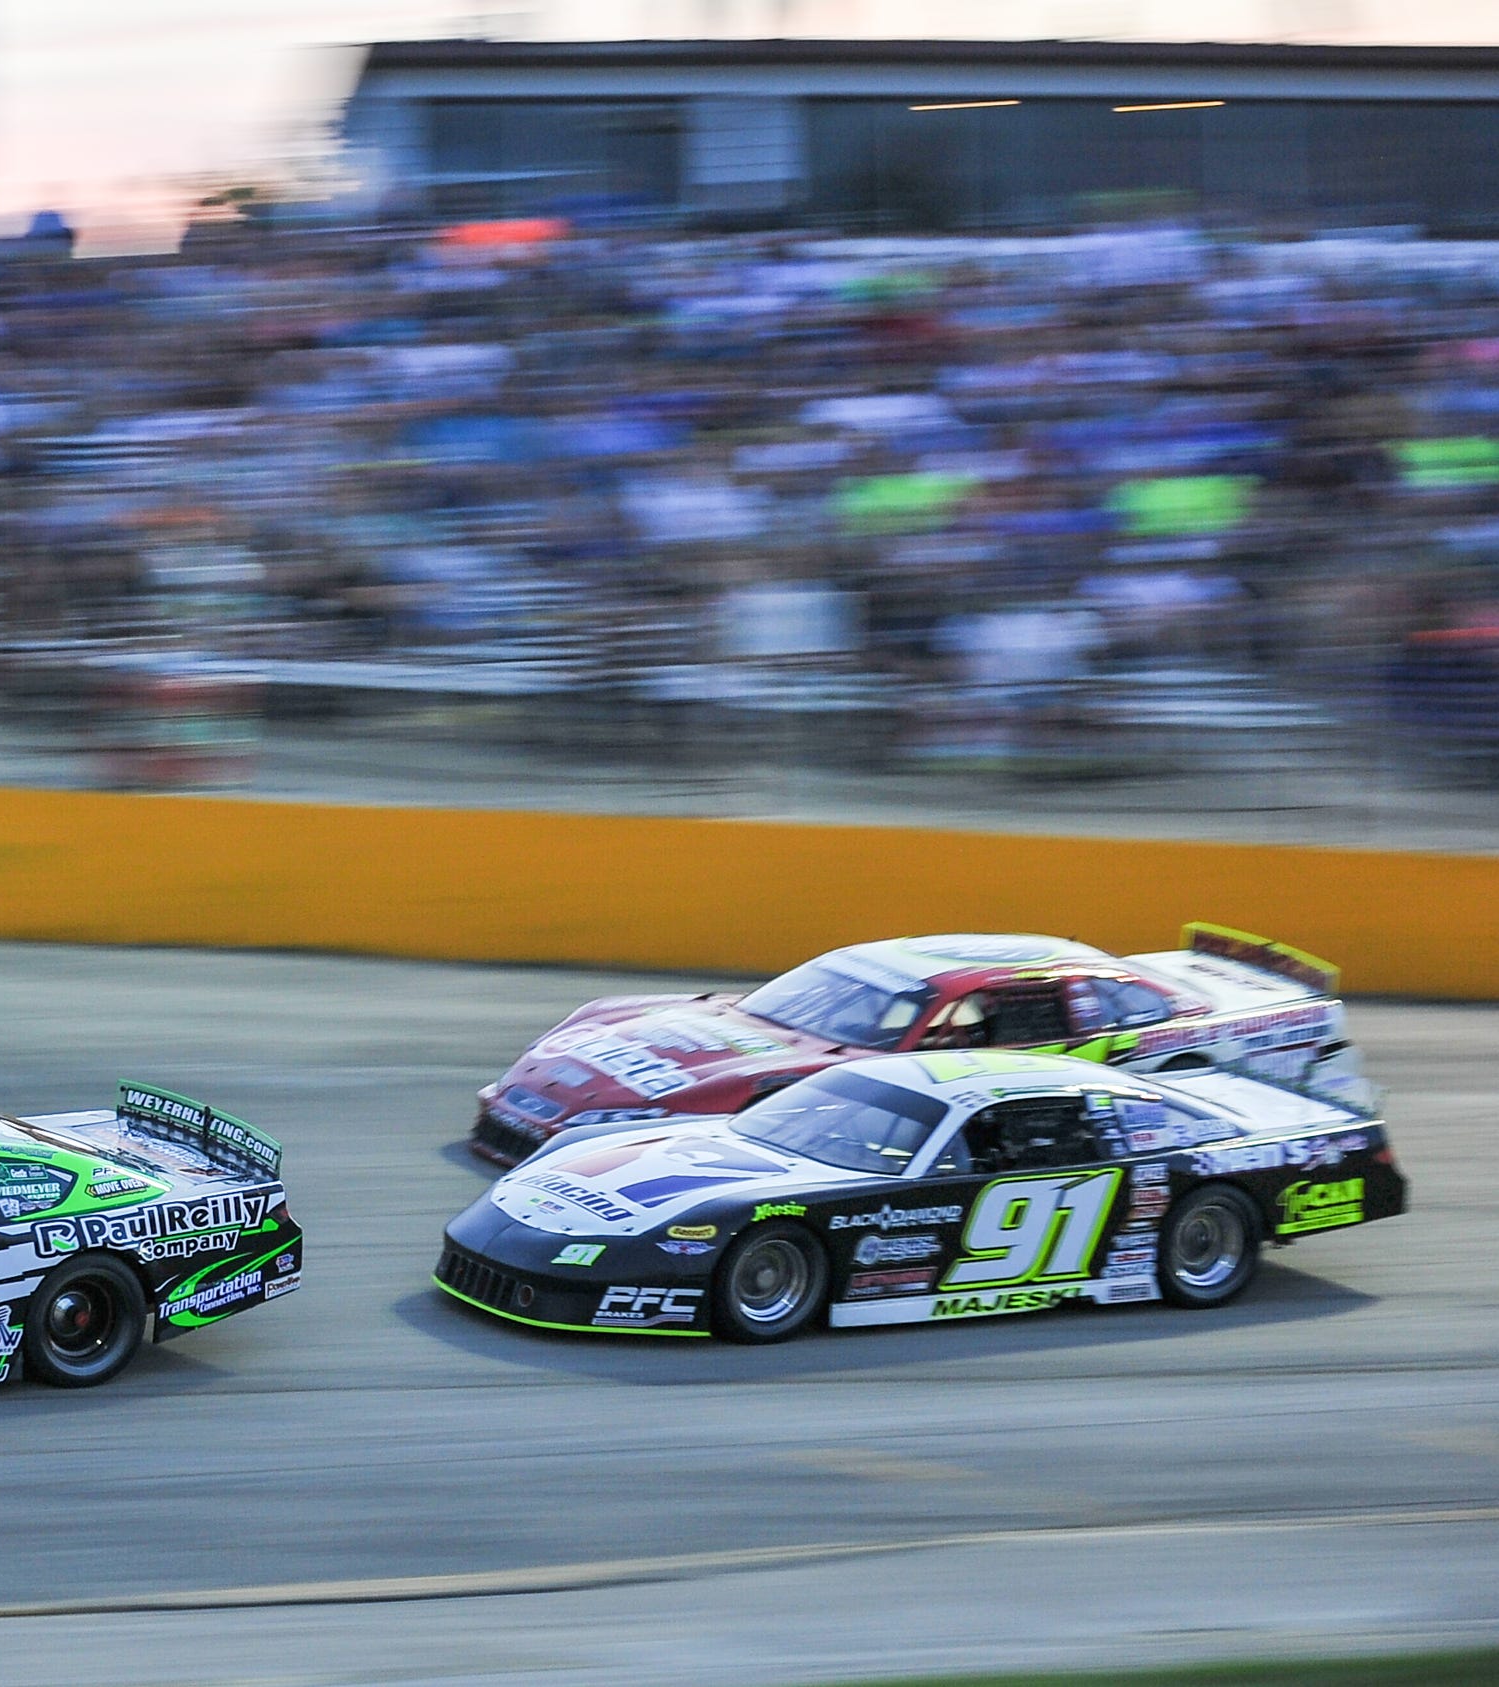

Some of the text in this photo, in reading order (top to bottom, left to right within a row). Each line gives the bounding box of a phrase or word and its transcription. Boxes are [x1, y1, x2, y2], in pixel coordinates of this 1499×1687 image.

[126, 1089, 276, 1162] WEYERHETING.com
[94, 1181, 122, 1195] MOVE
[82, 1193, 267, 1248] Paul Reilly
[937, 1167, 1124, 1291] 91
[140, 1230, 239, 1262] Company
[550, 1243, 607, 1267] 91
[159, 1270, 263, 1319] Transportation
[600, 1286, 705, 1313] PFC
[931, 1288, 1084, 1316] MAJESKI
